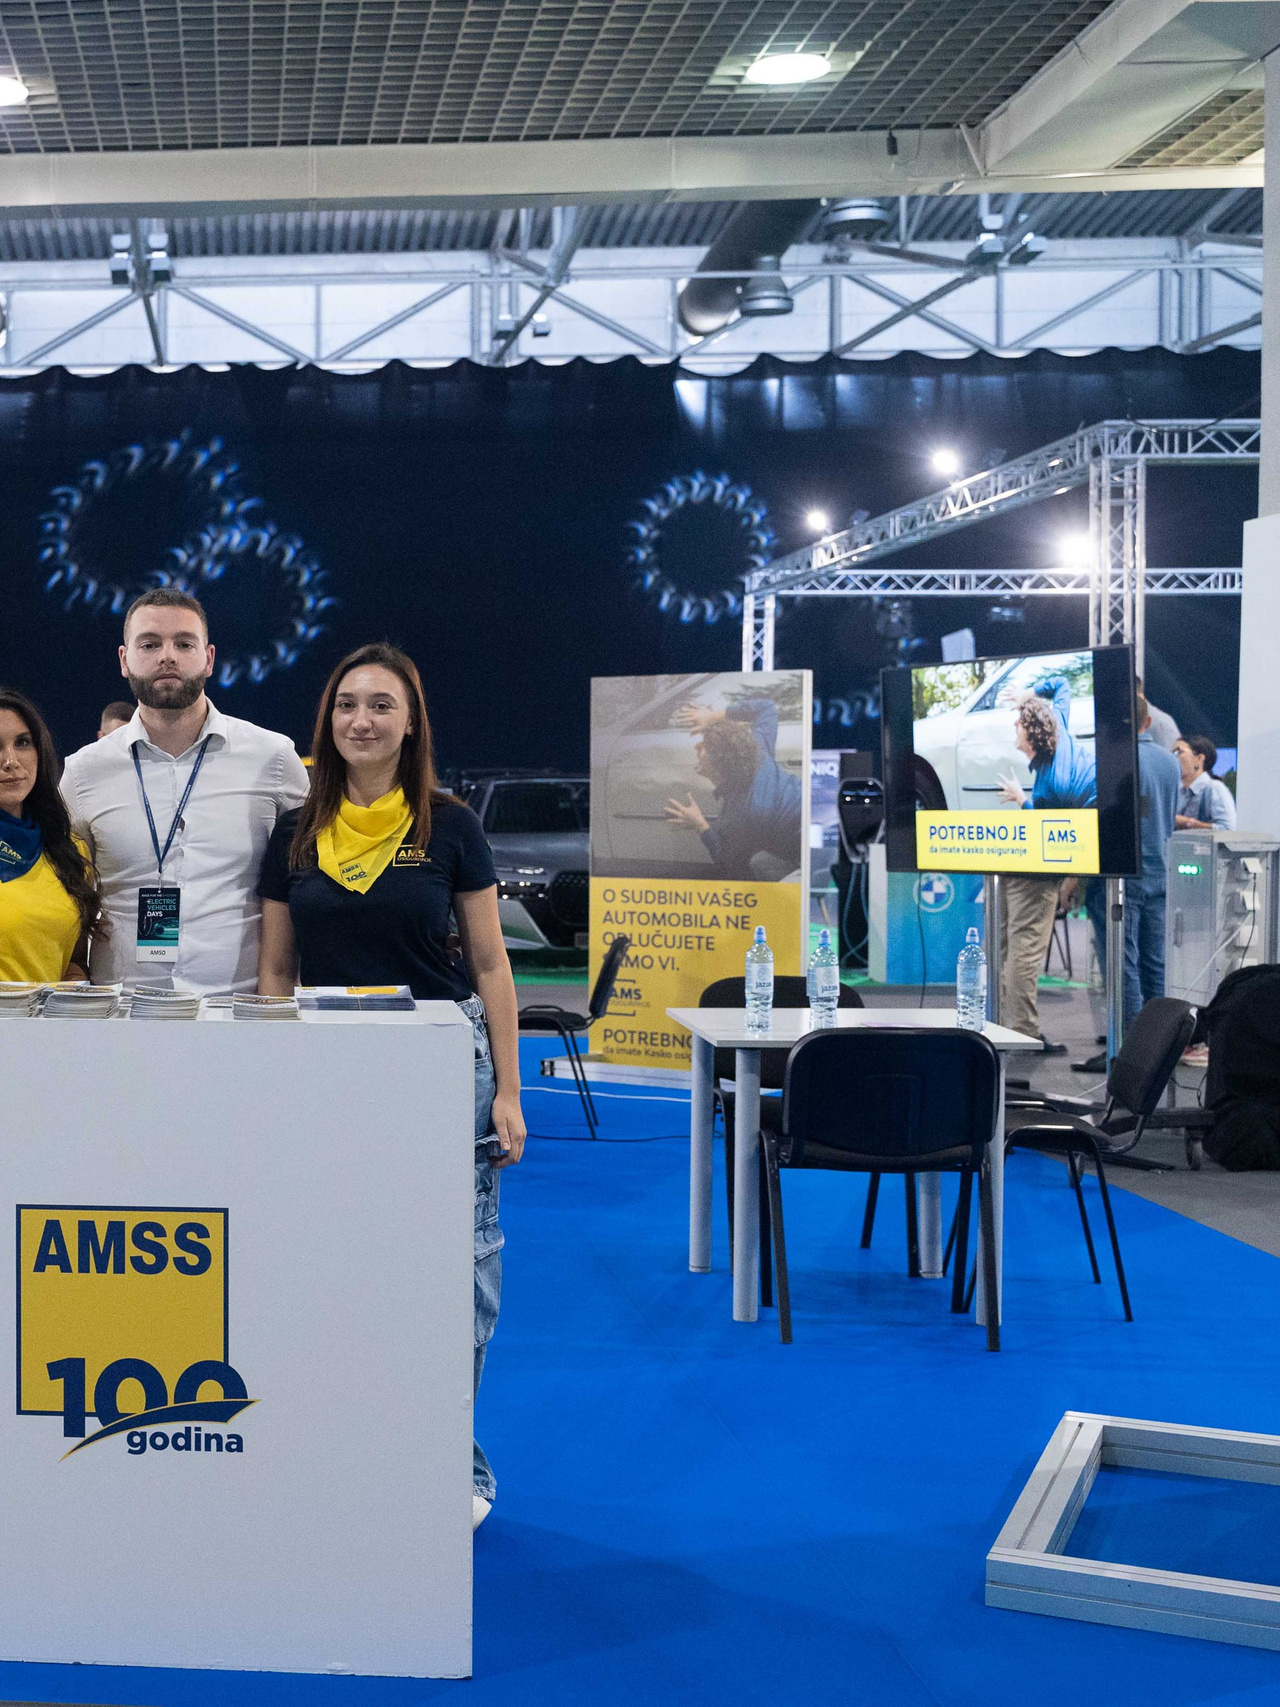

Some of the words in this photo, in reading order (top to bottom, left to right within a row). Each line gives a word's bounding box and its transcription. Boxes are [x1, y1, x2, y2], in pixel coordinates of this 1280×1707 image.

[929, 826, 1009, 841] POTREBNO
[1012, 826, 1027, 841] JE
[1048, 829, 1077, 843] AMS
[1, 846, 22, 860] AMS
[398, 849, 426, 858] AMS
[929, 845, 938, 854] da
[940, 845, 960, 854] imate
[963, 845, 984, 854] kasko
[986, 846, 1027, 857] osiguranje
[603, 889, 616, 903] O
[620, 889, 693, 906] SUDBINI
[697, 888, 758, 908] VAŠEG
[603, 911, 721, 929] AUTOMOBILA
[726, 915, 751, 930] NE
[659, 957, 680, 971] VI.
[33, 1219, 212, 1276] AMSS
[46, 1358, 249, 1438] 100
[126, 1427, 244, 1455] godina
